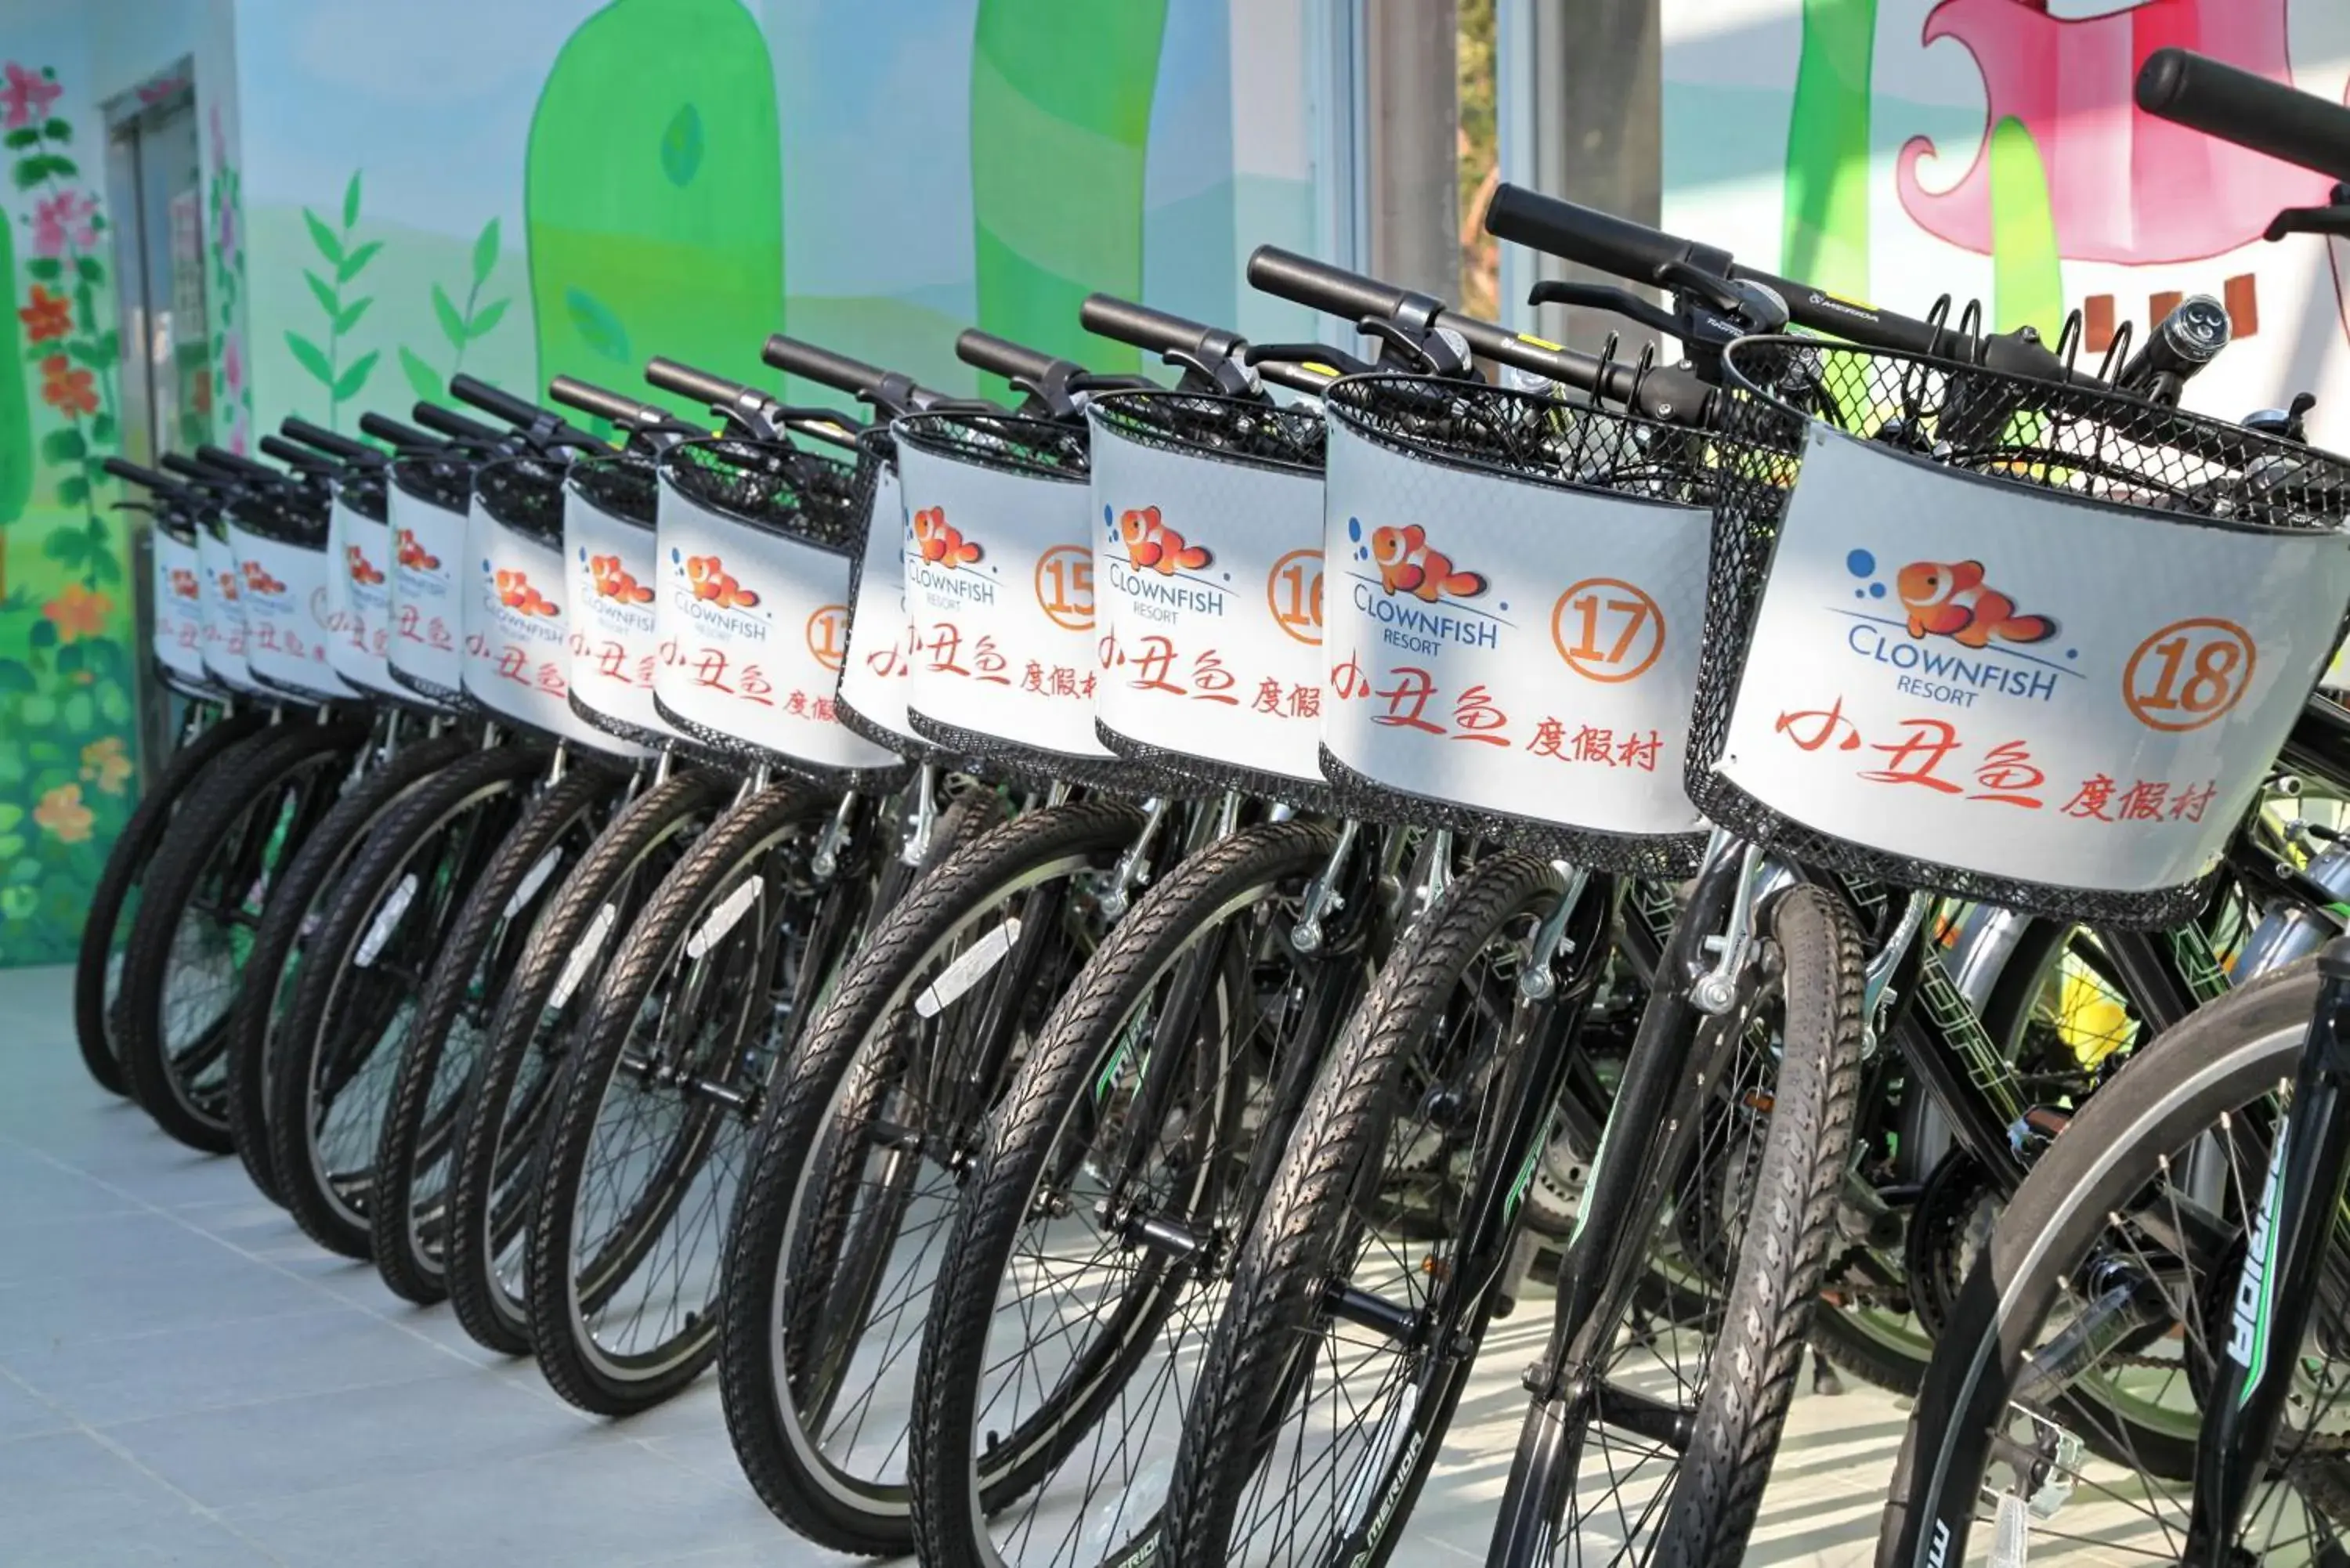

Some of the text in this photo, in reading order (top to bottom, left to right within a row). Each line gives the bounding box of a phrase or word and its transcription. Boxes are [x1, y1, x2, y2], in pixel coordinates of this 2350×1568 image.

[909, 559, 995, 605] CLOWNFISH
[1046, 559, 1095, 616] 15
[1110, 563, 1224, 616] CLOWNFISH
[674, 591, 766, 642] CLOWNFISH
[1133, 601, 1180, 626] RESORT
[1353, 583, 1498, 649] CLOWNFISH
[1383, 627, 1441, 657] RESORT
[1568, 594, 1648, 663] 17
[1098, 621, 1321, 719] 小丑鱼度假
[1849, 623, 2059, 703] CLOWNFISH
[1897, 674, 1979, 709] RESORT
[2137, 637, 2242, 713] 18
[1367, 1431, 1423, 1548] MERIDA
